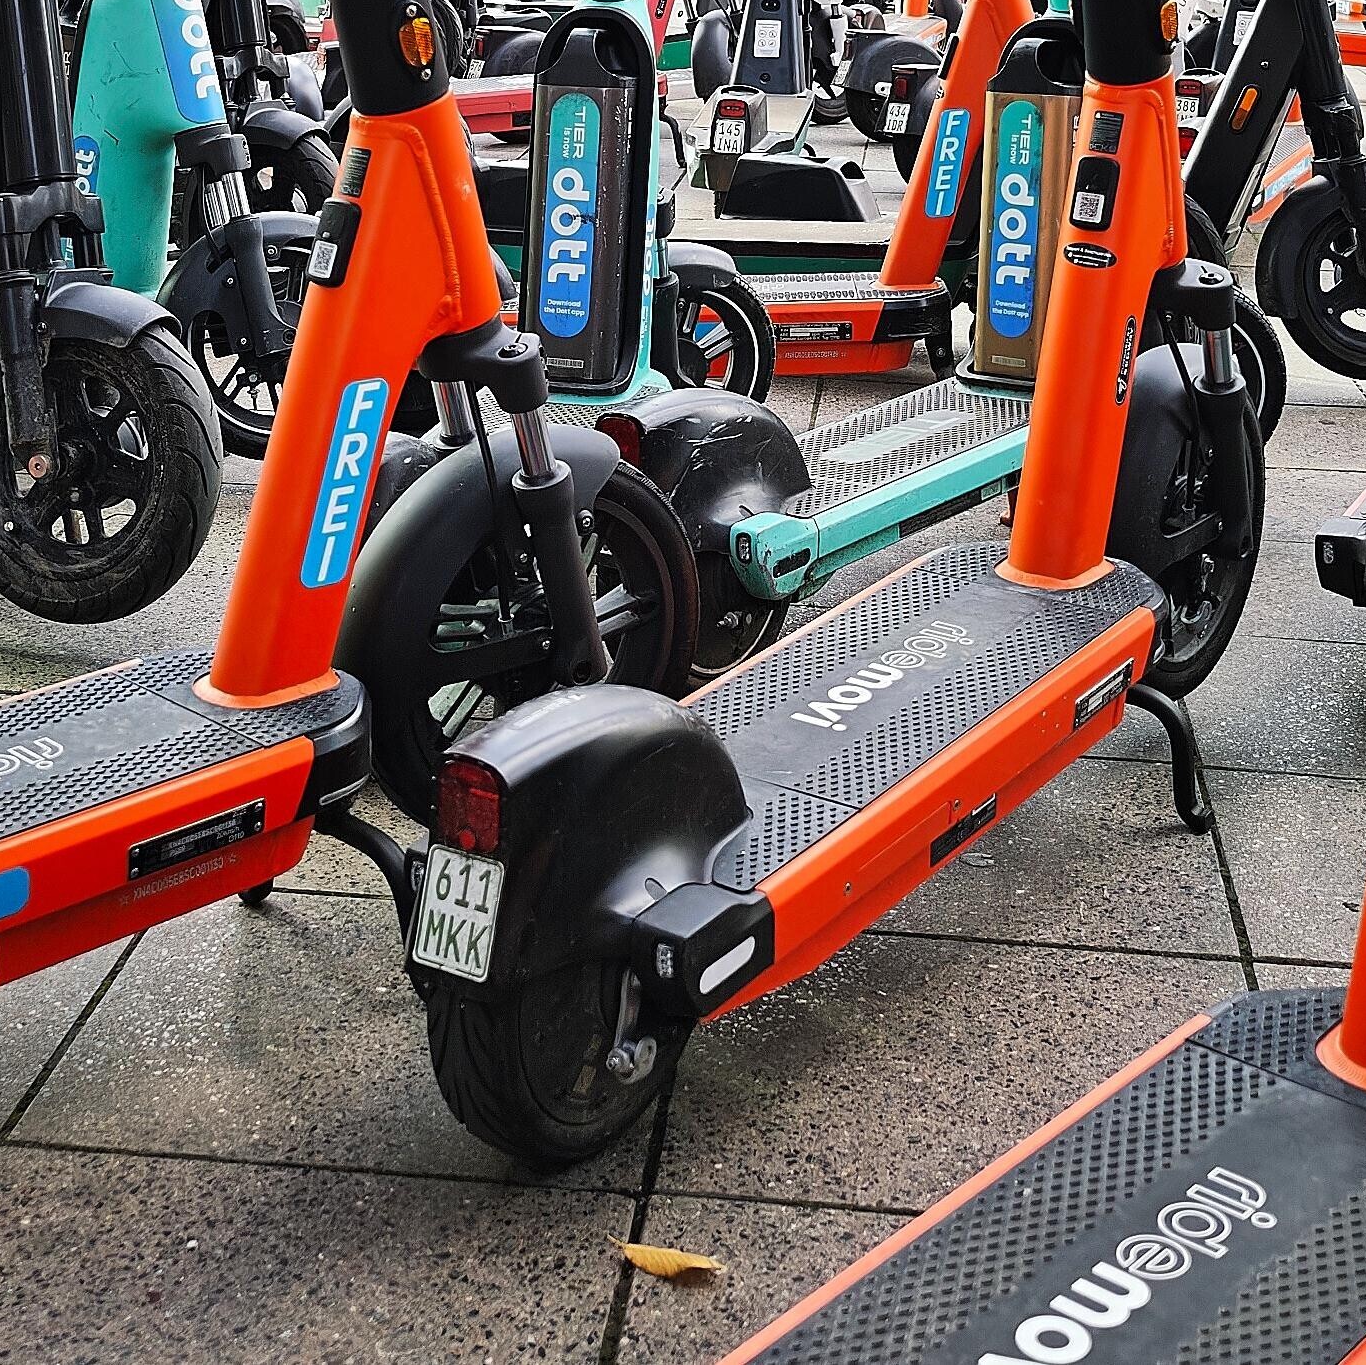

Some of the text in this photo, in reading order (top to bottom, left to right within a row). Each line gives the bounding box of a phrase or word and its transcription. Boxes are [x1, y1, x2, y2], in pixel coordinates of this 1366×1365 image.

[572, 106, 587, 159] TIER
[718, 122, 741, 136] 145
[889, 105, 907, 119] 434
[562, 137, 570, 159] now
[717, 137, 739, 153] INA
[934, 110, 965, 216] FREI
[1009, 145, 1018, 166] now
[1019, 114, 1032, 165] TIER
[75, 148, 96, 195] ott
[547, 167, 591, 284] dott
[995, 172, 1035, 285] dott
[544, 306, 555, 315] the
[571, 309, 585, 318] app
[547, 298, 582, 308] Download
[995, 299, 1026, 311] Download
[316, 381, 381, 583] FREI
[789, 619, 975, 733] ridemovi
[435, 857, 492, 915] 611
[423, 908, 491, 969] MKK
[977, 1165, 1278, 1365] ridemo
